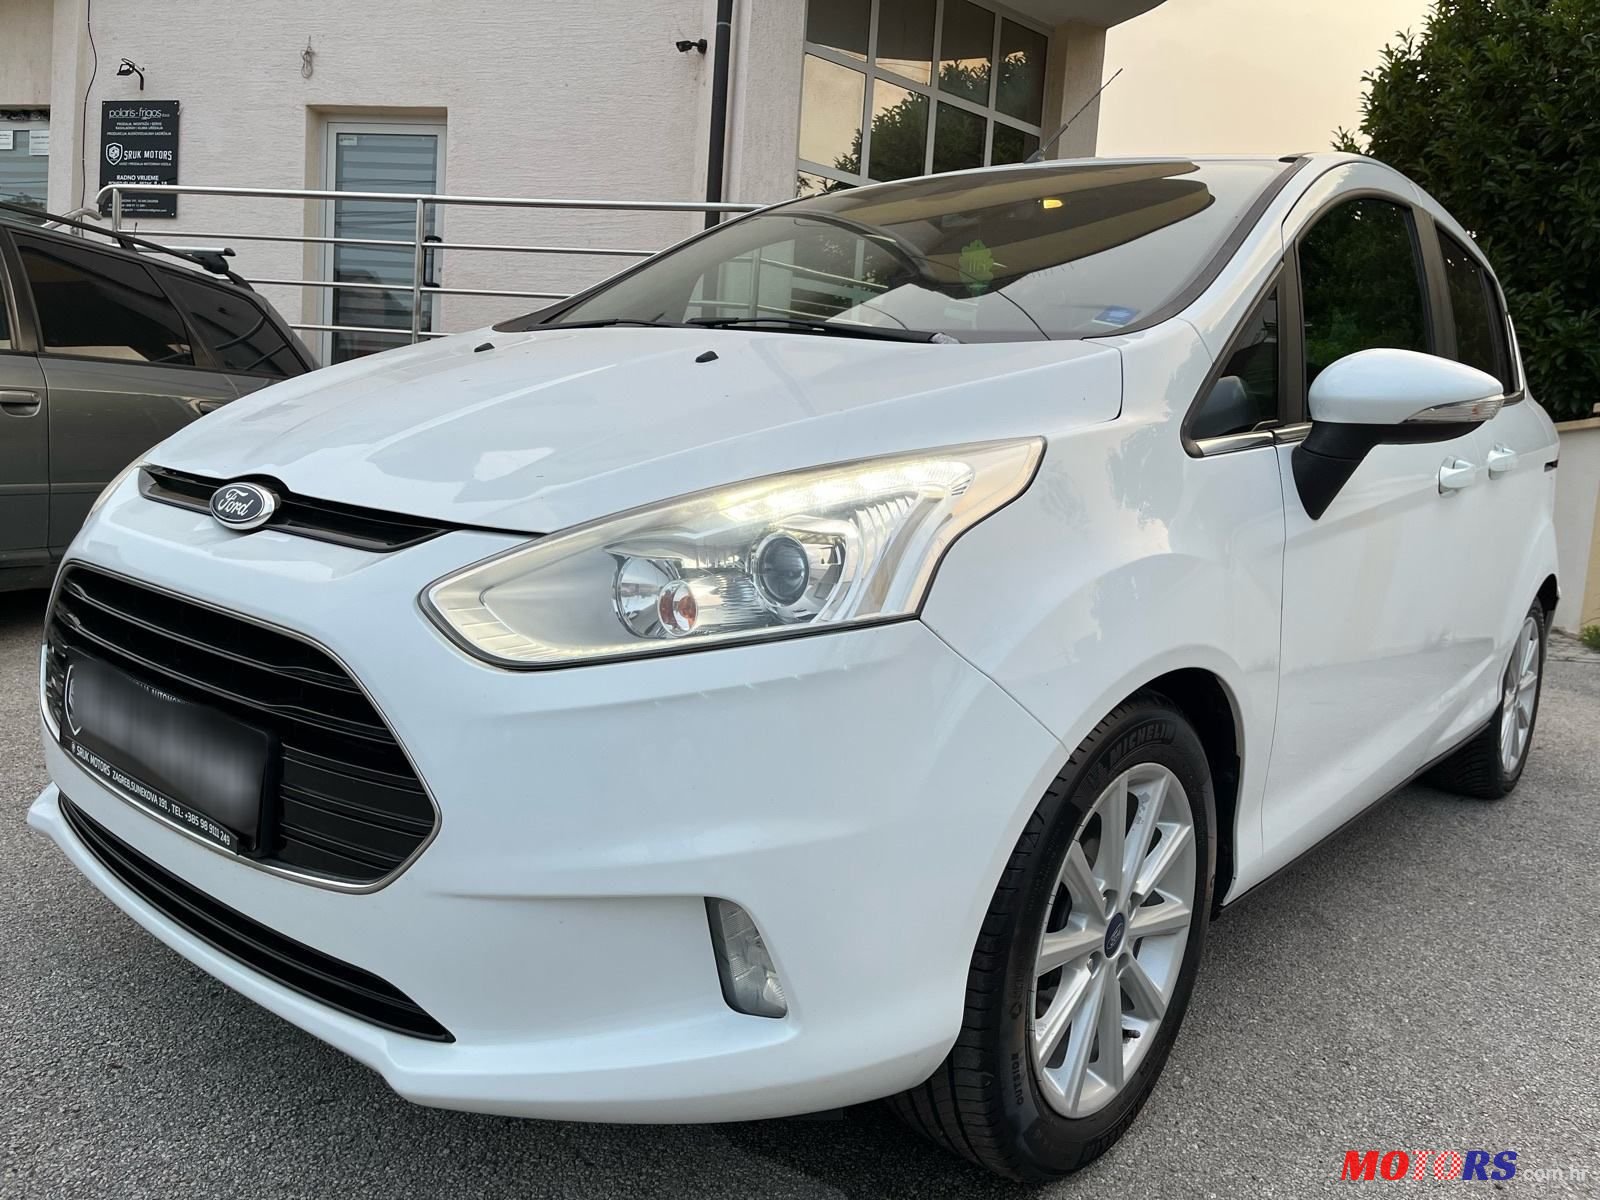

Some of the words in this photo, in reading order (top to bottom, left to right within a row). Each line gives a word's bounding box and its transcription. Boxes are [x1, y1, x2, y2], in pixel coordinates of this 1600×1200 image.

[123, 150, 142, 160] SRUK
[144, 150, 173, 160] MOTORS
[217, 488, 254, 516] Ford
[76, 745, 90, 762] SRUK
[90, 754, 110, 776] MOTORS
[171, 803, 184, 818] TEL:
[184, 811, 199, 826] +385
[200, 818, 208, 831] 98
[220, 831, 231, 846] 249
[1010, 1053, 1025, 1106] OUTSIDE
